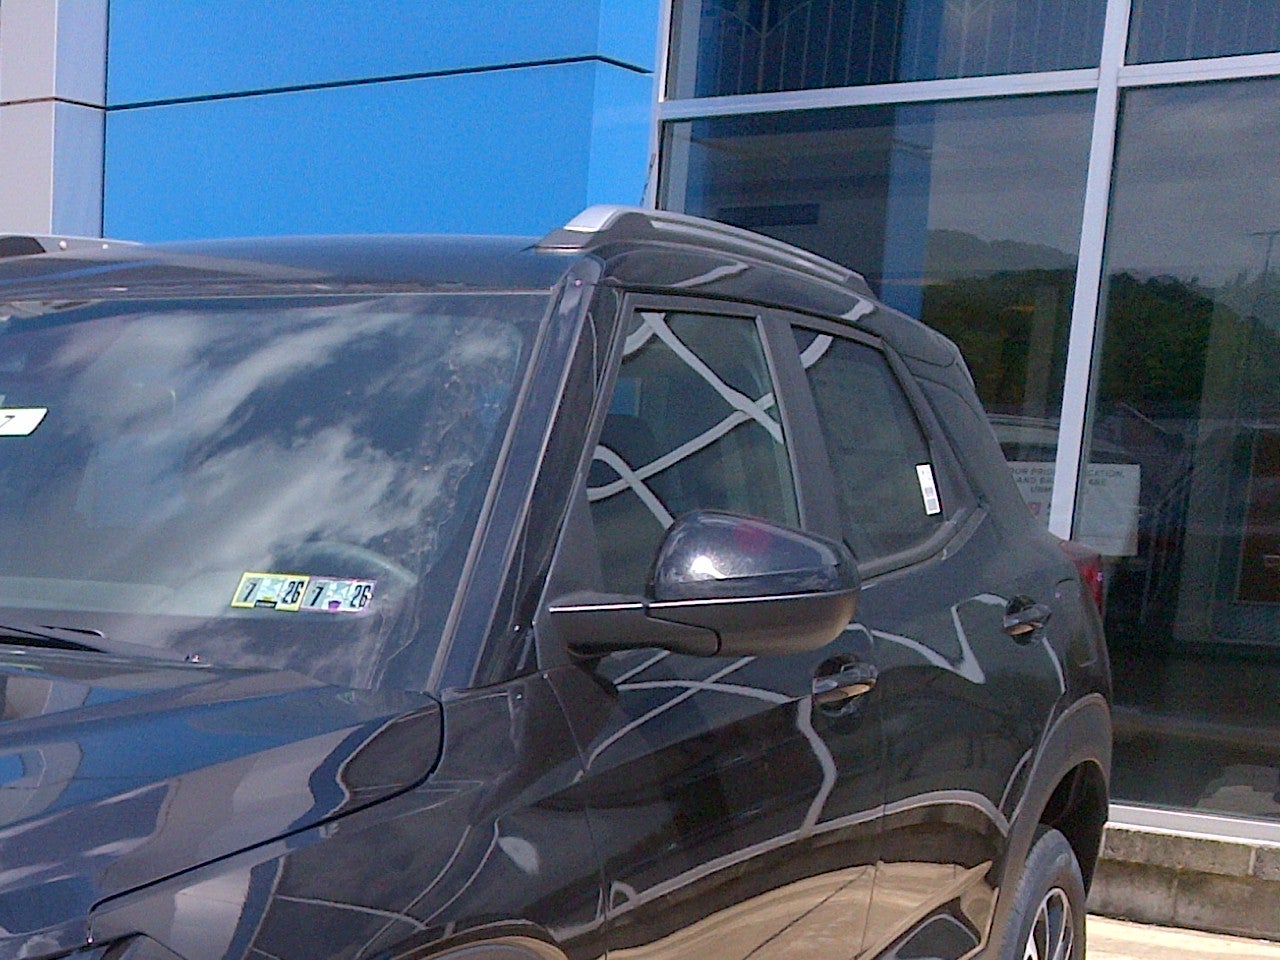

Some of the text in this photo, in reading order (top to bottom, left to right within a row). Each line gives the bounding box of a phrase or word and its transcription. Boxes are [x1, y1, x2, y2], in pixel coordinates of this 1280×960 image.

[243, 581, 304, 604] 7 26
[311, 586, 324, 607] 7
